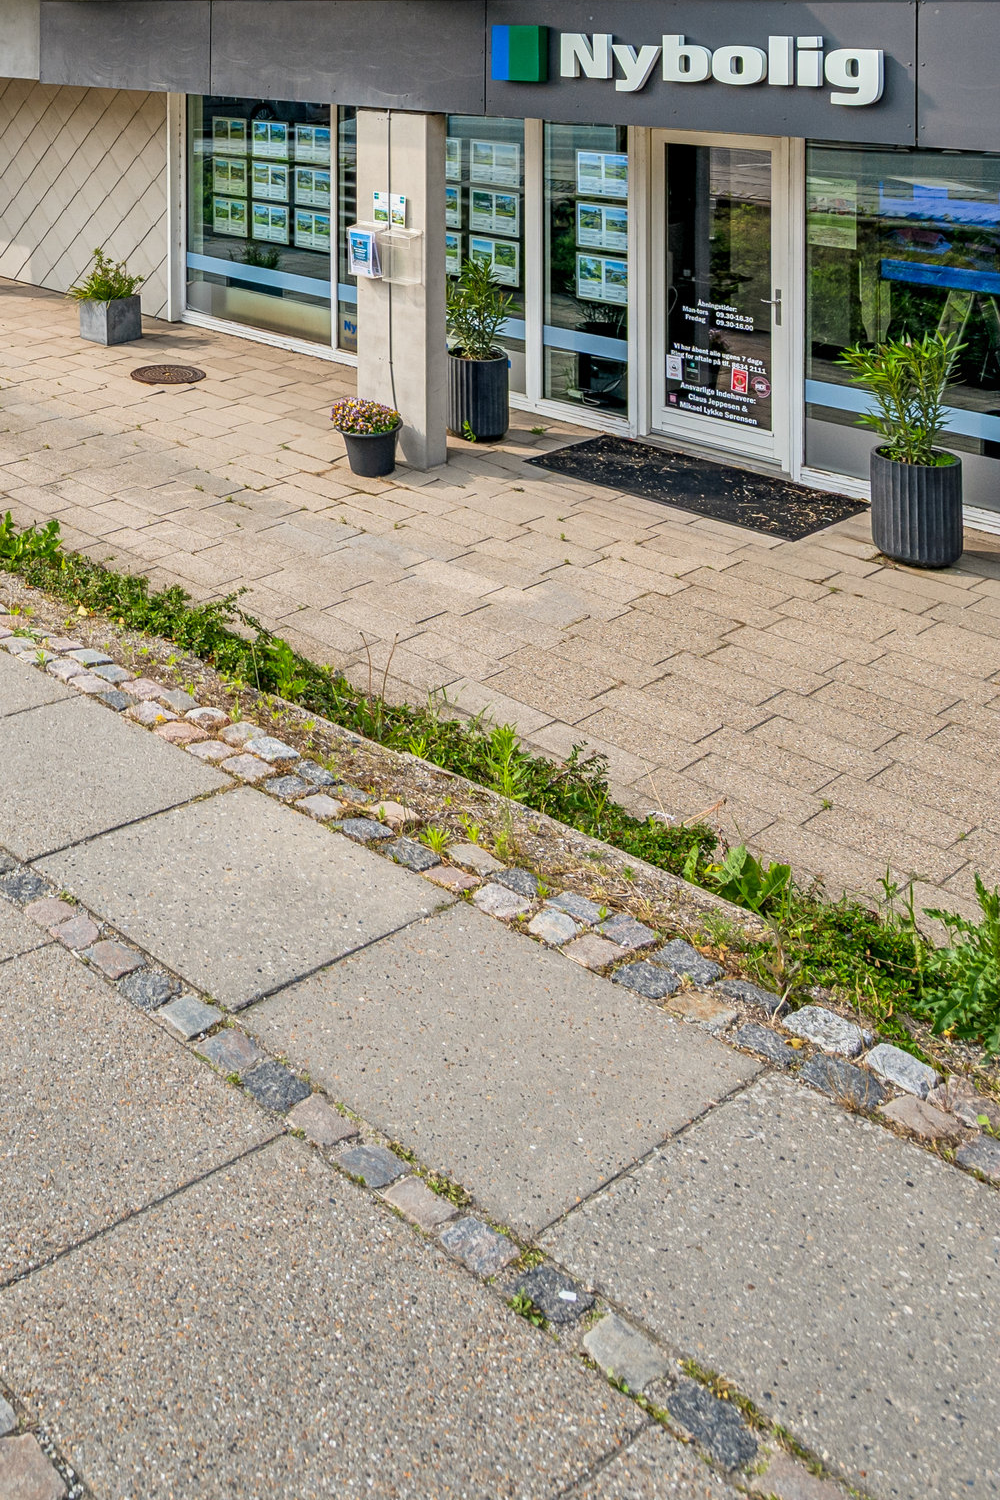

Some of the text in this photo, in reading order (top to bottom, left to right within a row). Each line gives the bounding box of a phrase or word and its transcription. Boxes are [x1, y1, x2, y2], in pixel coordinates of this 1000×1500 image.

[560, 32, 884, 106] Nybolig
[685, 313, 706, 324] Fredag
[681, 343, 691, 352] har
[709, 349, 721, 358] alle
[721, 352, 741, 362] ugens
[747, 356, 763, 366] dage
[685, 352, 694, 360] for
[694, 354, 713, 364] aftale
[712, 358, 721, 367] på
[749, 365, 767, 375] 2111
[680, 381, 715, 396] Ansvarlige
[679, 401, 758, 425] Mikael Lykke Sørensen
[688, 393, 748, 413] Claus Jeppesen &
